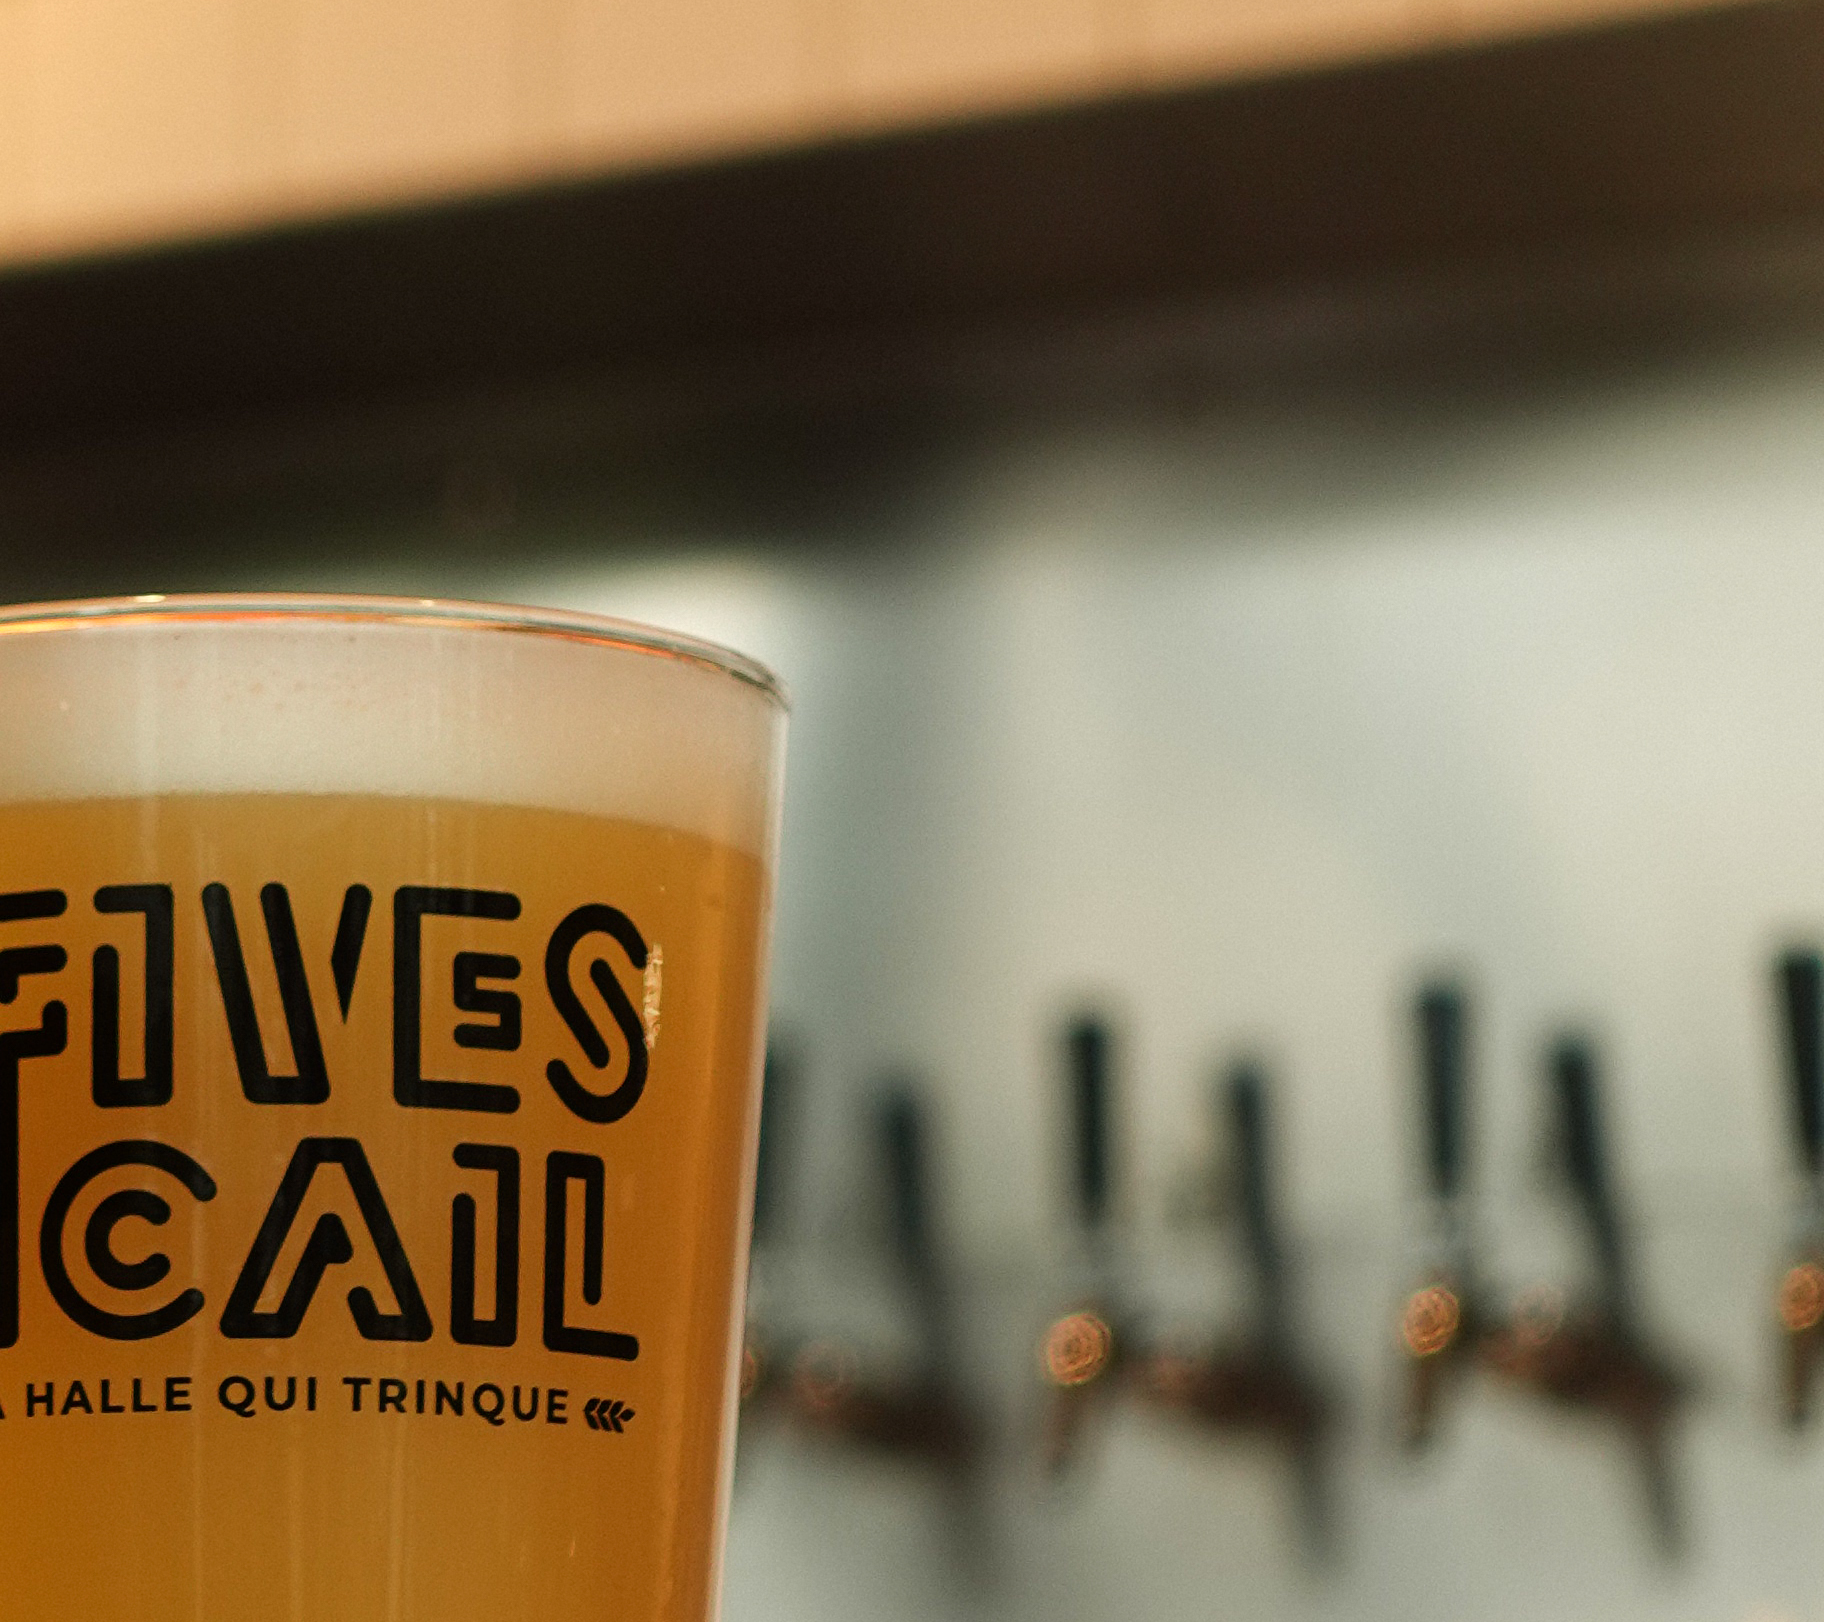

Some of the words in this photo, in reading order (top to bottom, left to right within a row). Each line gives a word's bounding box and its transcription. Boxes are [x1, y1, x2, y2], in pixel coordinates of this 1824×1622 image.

[38, 1133, 644, 1364] CAIL
[26, 1376, 193, 1418] HALLE
[217, 1375, 318, 1419] QUI
[342, 1376, 569, 1427] TRINQUE
